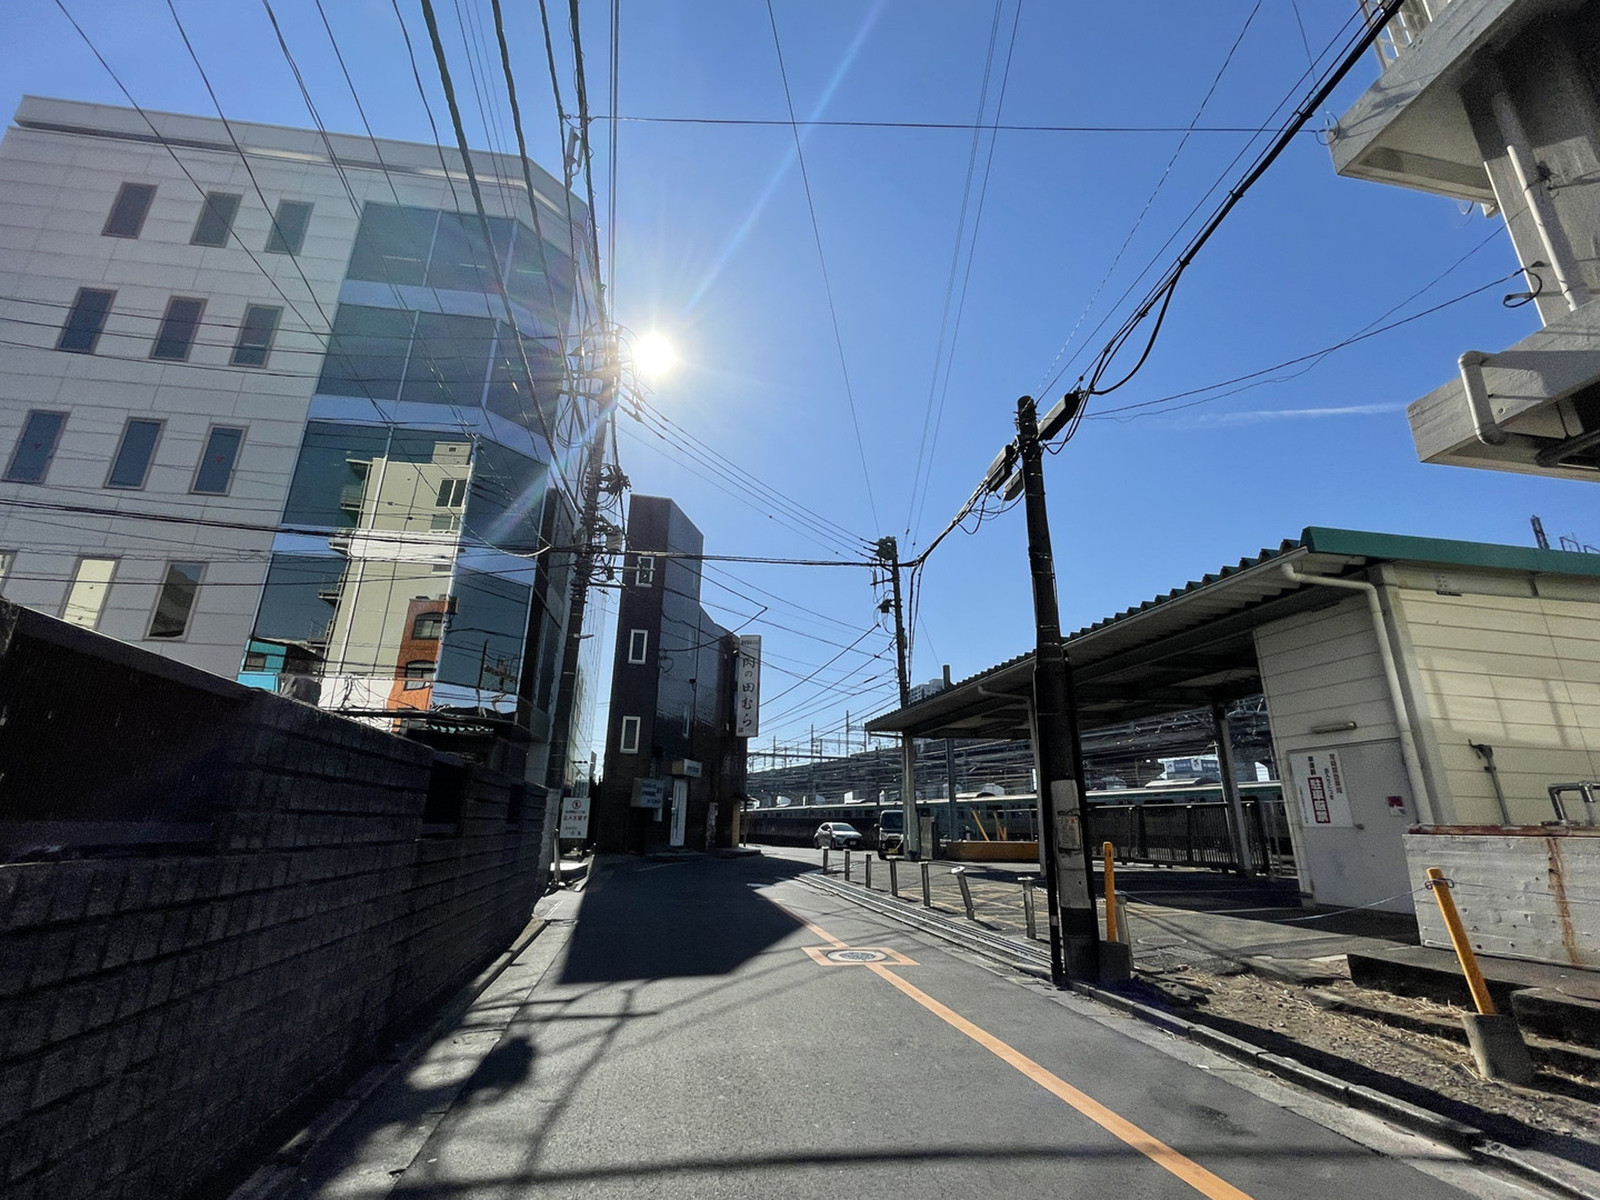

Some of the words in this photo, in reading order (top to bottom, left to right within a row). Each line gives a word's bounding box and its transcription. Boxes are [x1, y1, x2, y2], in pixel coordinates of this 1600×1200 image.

[741, 656, 756, 728] 肉の田むら
